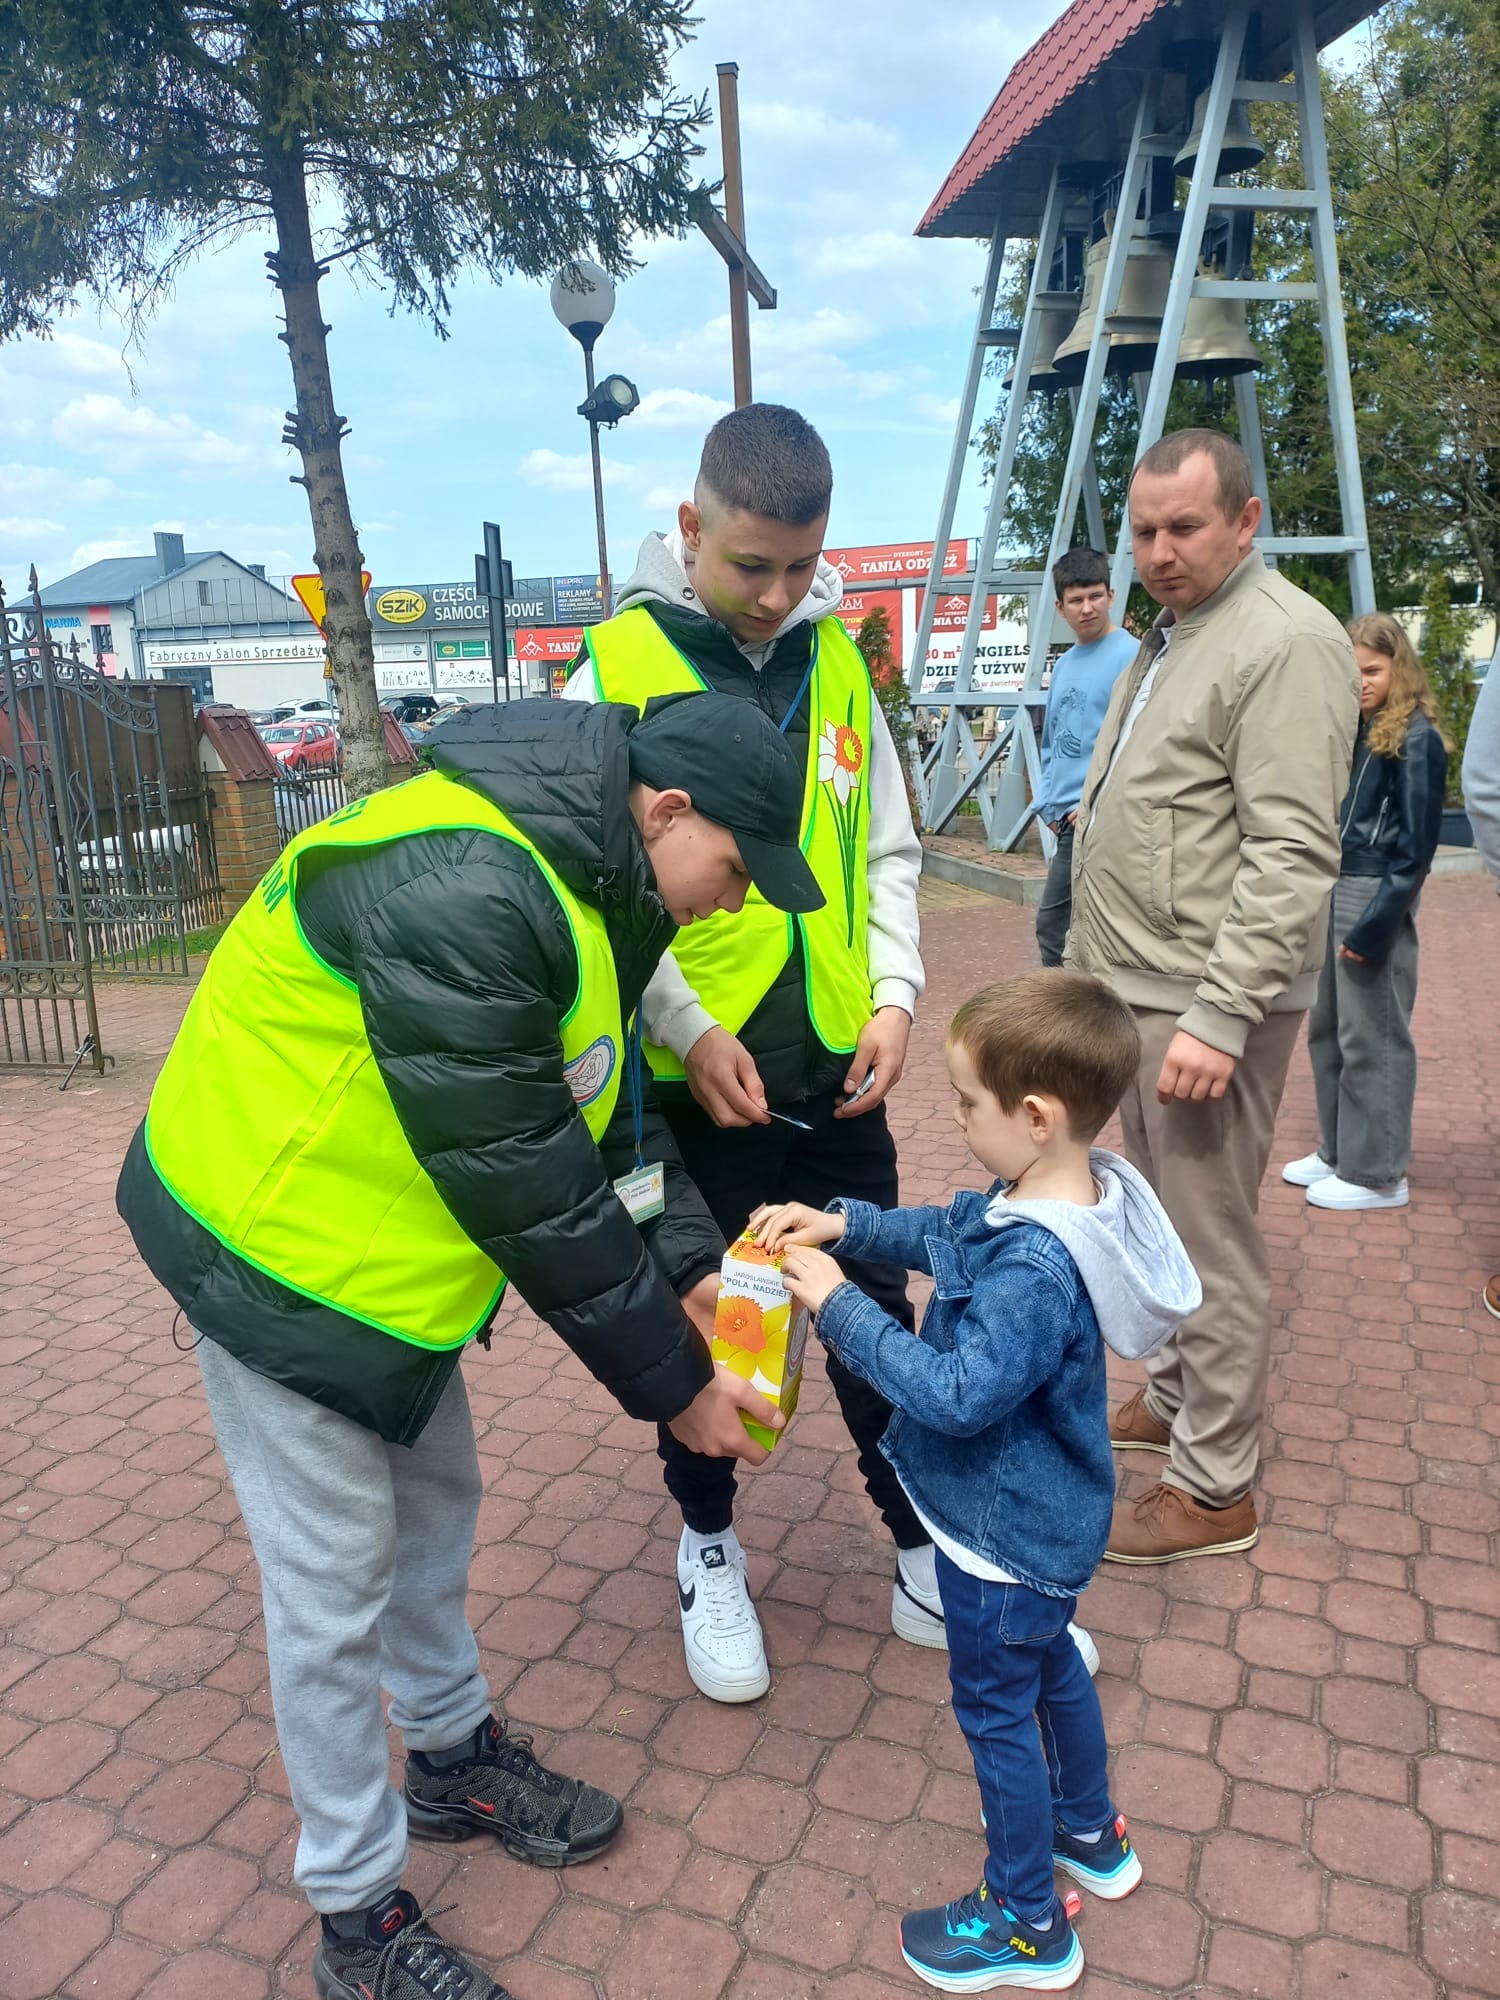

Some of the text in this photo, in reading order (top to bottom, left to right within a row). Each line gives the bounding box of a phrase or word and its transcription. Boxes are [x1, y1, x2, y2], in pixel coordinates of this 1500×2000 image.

[861, 553, 958, 574] TANIA ODZEŻ
[557, 588, 592, 598] REKLAMY
[434, 602, 545, 620] SAMOCHDOWE
[546, 641, 582, 653] TANIA
[150, 650, 212, 663] Fabryczny
[216, 648, 250, 660] Salon
[1009, 1936, 1037, 1957] FILA
